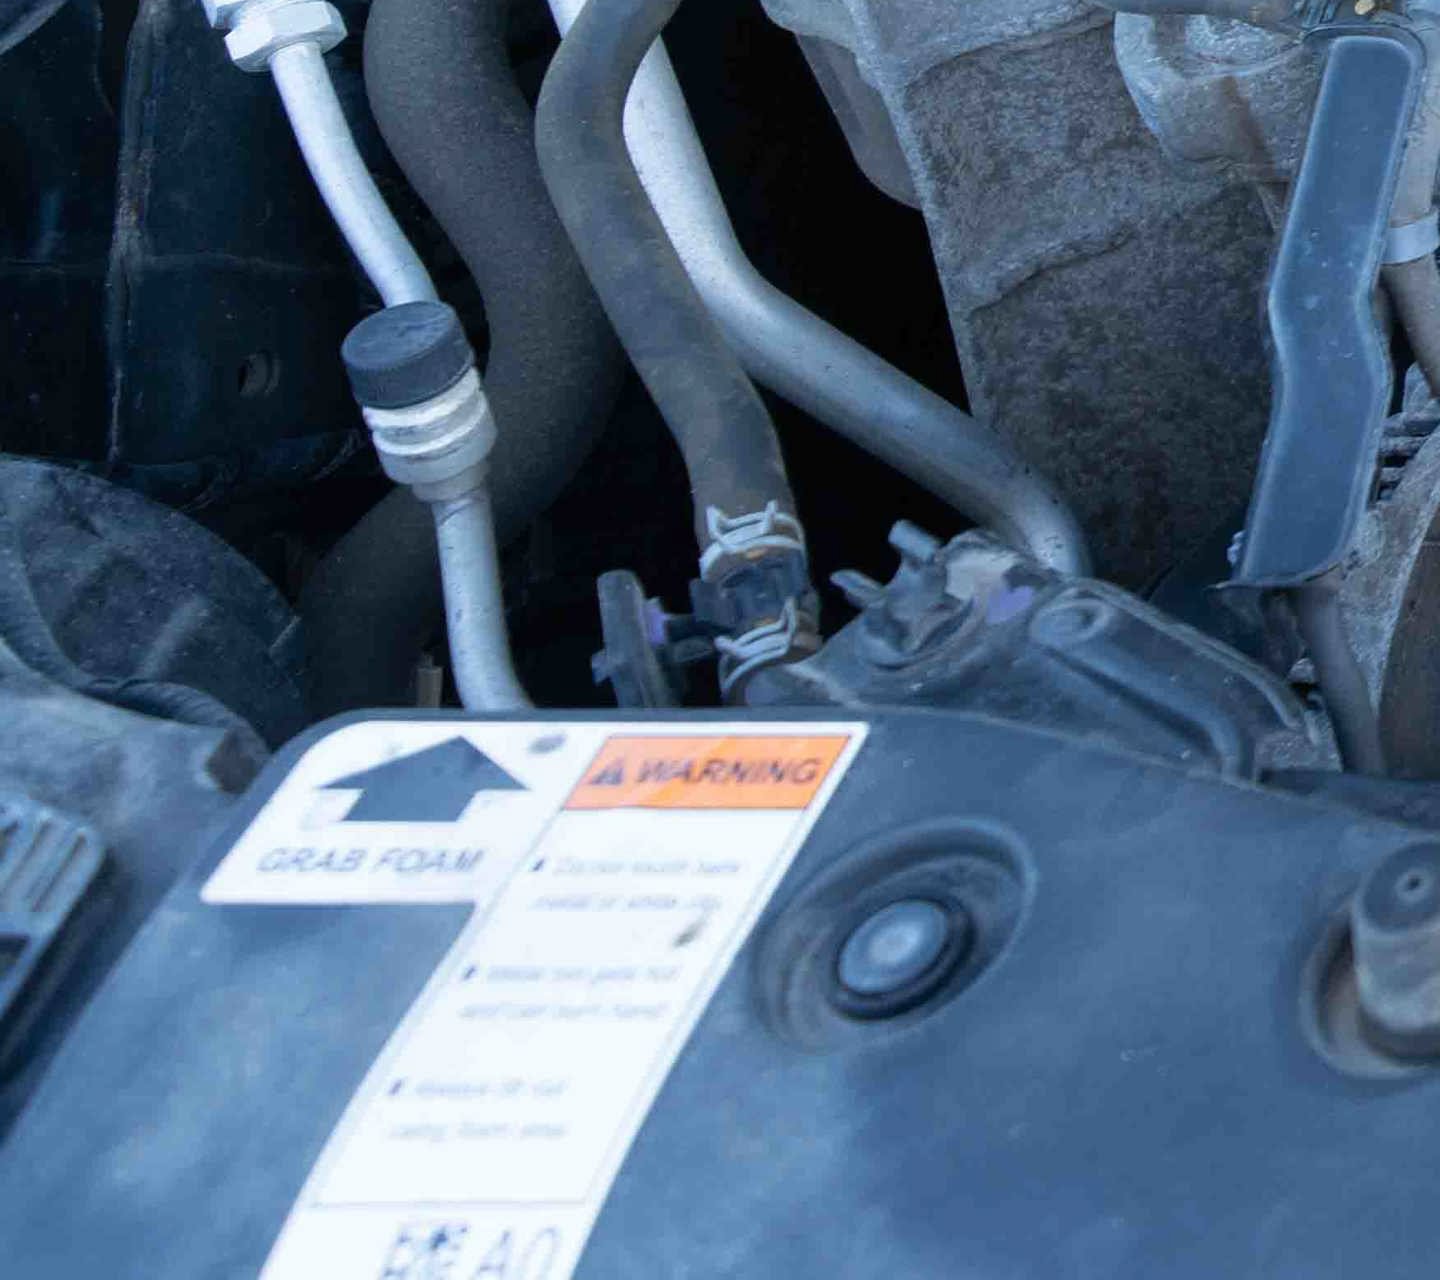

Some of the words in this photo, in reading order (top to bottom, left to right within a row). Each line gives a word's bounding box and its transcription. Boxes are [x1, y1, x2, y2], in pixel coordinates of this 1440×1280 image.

[636, 757, 822, 784] WARNING
[256, 847, 369, 873] GRAB
[372, 847, 486, 873] FOAM
